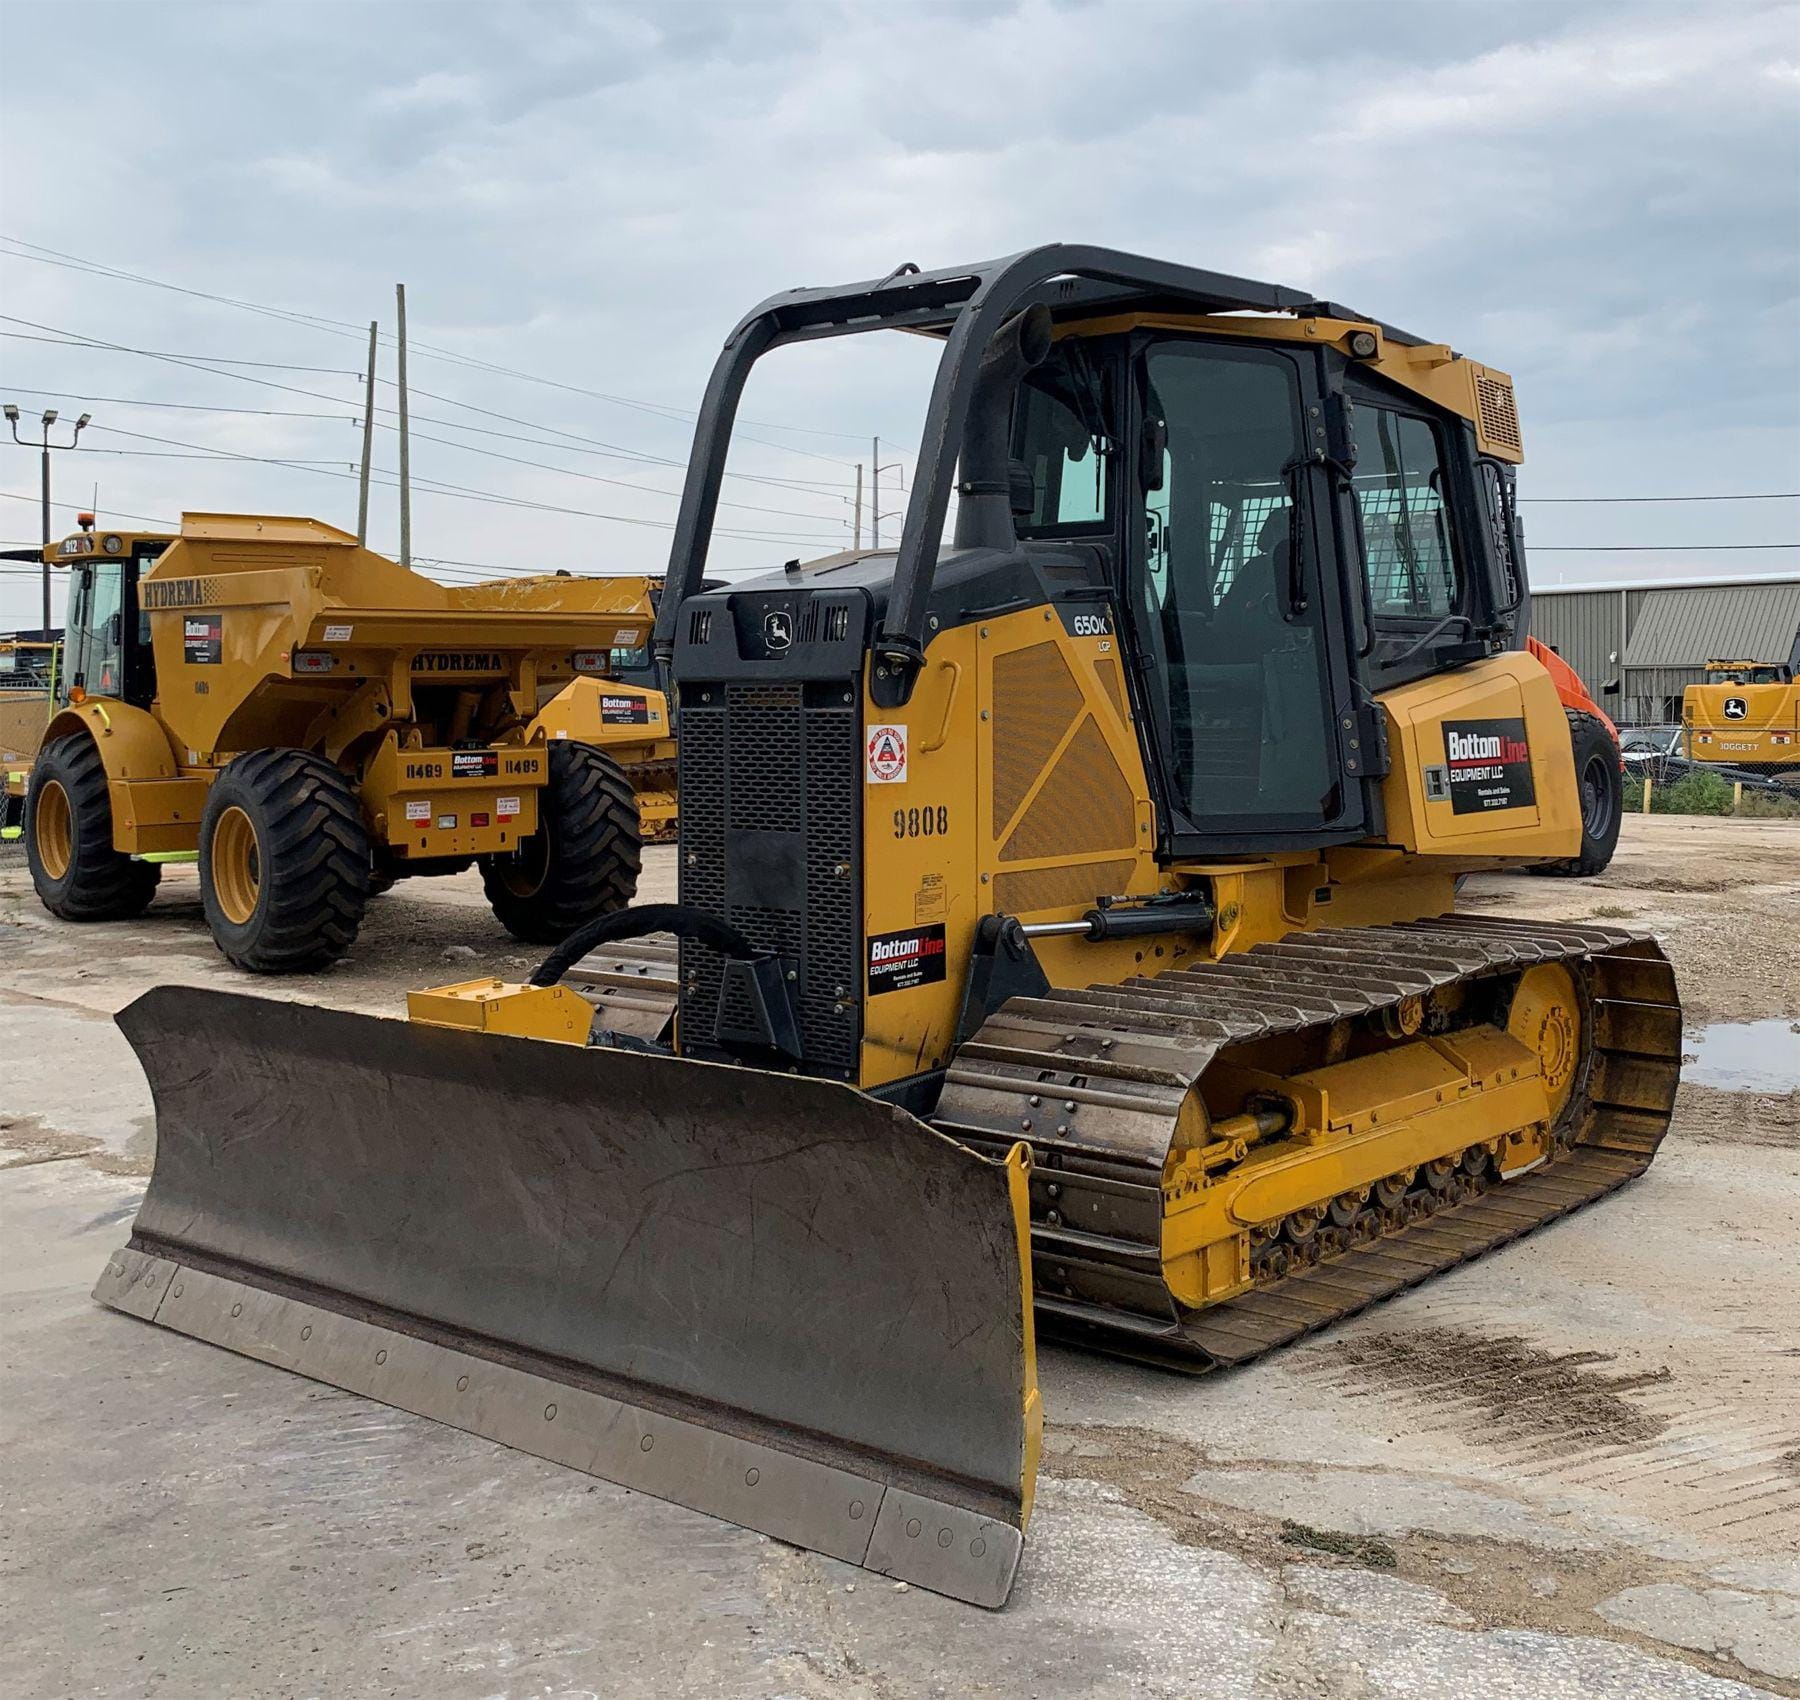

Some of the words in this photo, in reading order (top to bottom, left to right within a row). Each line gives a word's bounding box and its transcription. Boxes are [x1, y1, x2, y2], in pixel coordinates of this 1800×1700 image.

[144, 579, 202, 607] HYDREMA
[1074, 615, 1108, 635] 650K
[411, 653, 503, 671] HYDREMA
[406, 763, 443, 779] 11489
[504, 759, 539, 775] 11489
[1450, 766, 1491, 783] EQUIPMENT
[1491, 765, 1504, 779] LLC
[894, 805, 948, 839] 9808
[870, 959, 908, 976] EQUIPMENT
[907, 958, 919, 968] LLC
